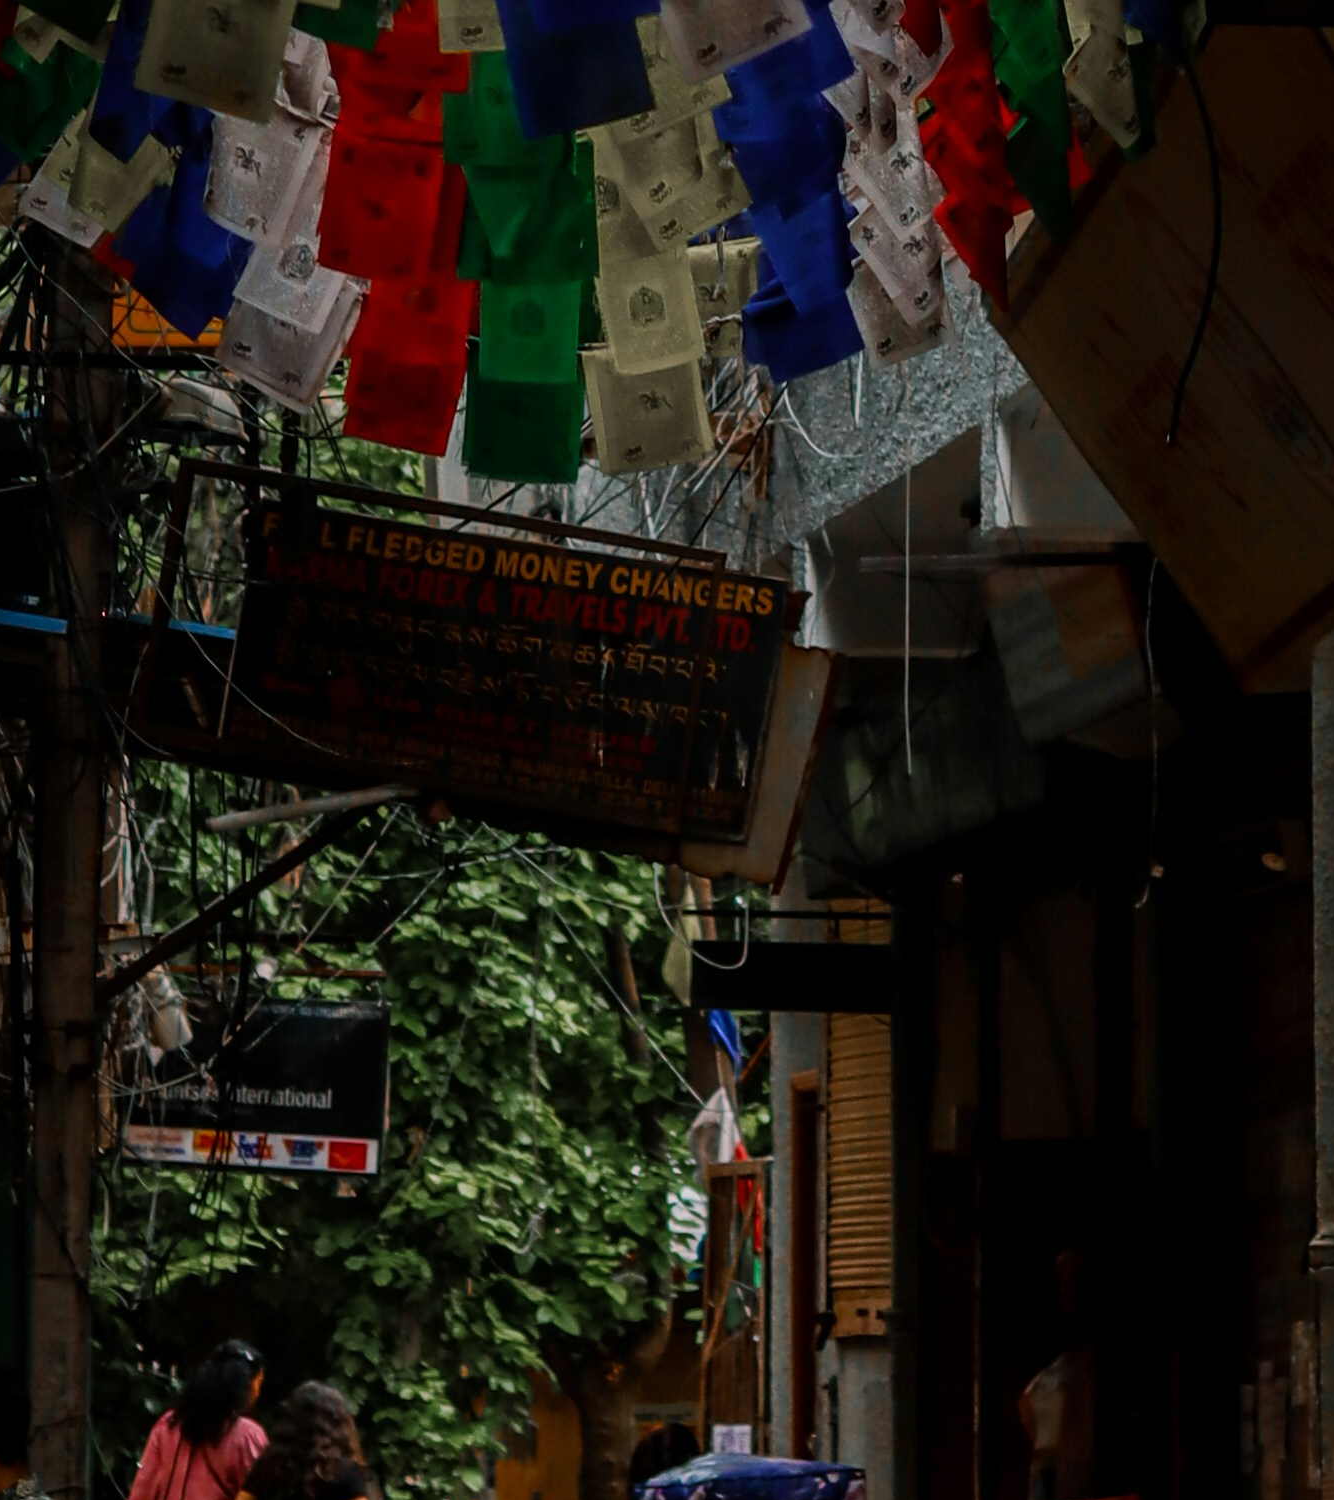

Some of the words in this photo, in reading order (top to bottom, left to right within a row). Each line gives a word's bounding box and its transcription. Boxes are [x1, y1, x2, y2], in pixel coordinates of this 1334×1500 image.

[261, 507, 345, 549] FL
[346, 527, 486, 575] FLEDGED
[494, 550, 605, 591] MONEY
[609, 566, 775, 617] CHANGERS
[376, 562, 469, 609] FOREX
[477, 581, 498, 612] &
[509, 587, 630, 638] TRAVELS
[637, 606, 691, 645] PVT.
[699, 614, 757, 654] TD.
[230, 1082, 333, 1111] International
